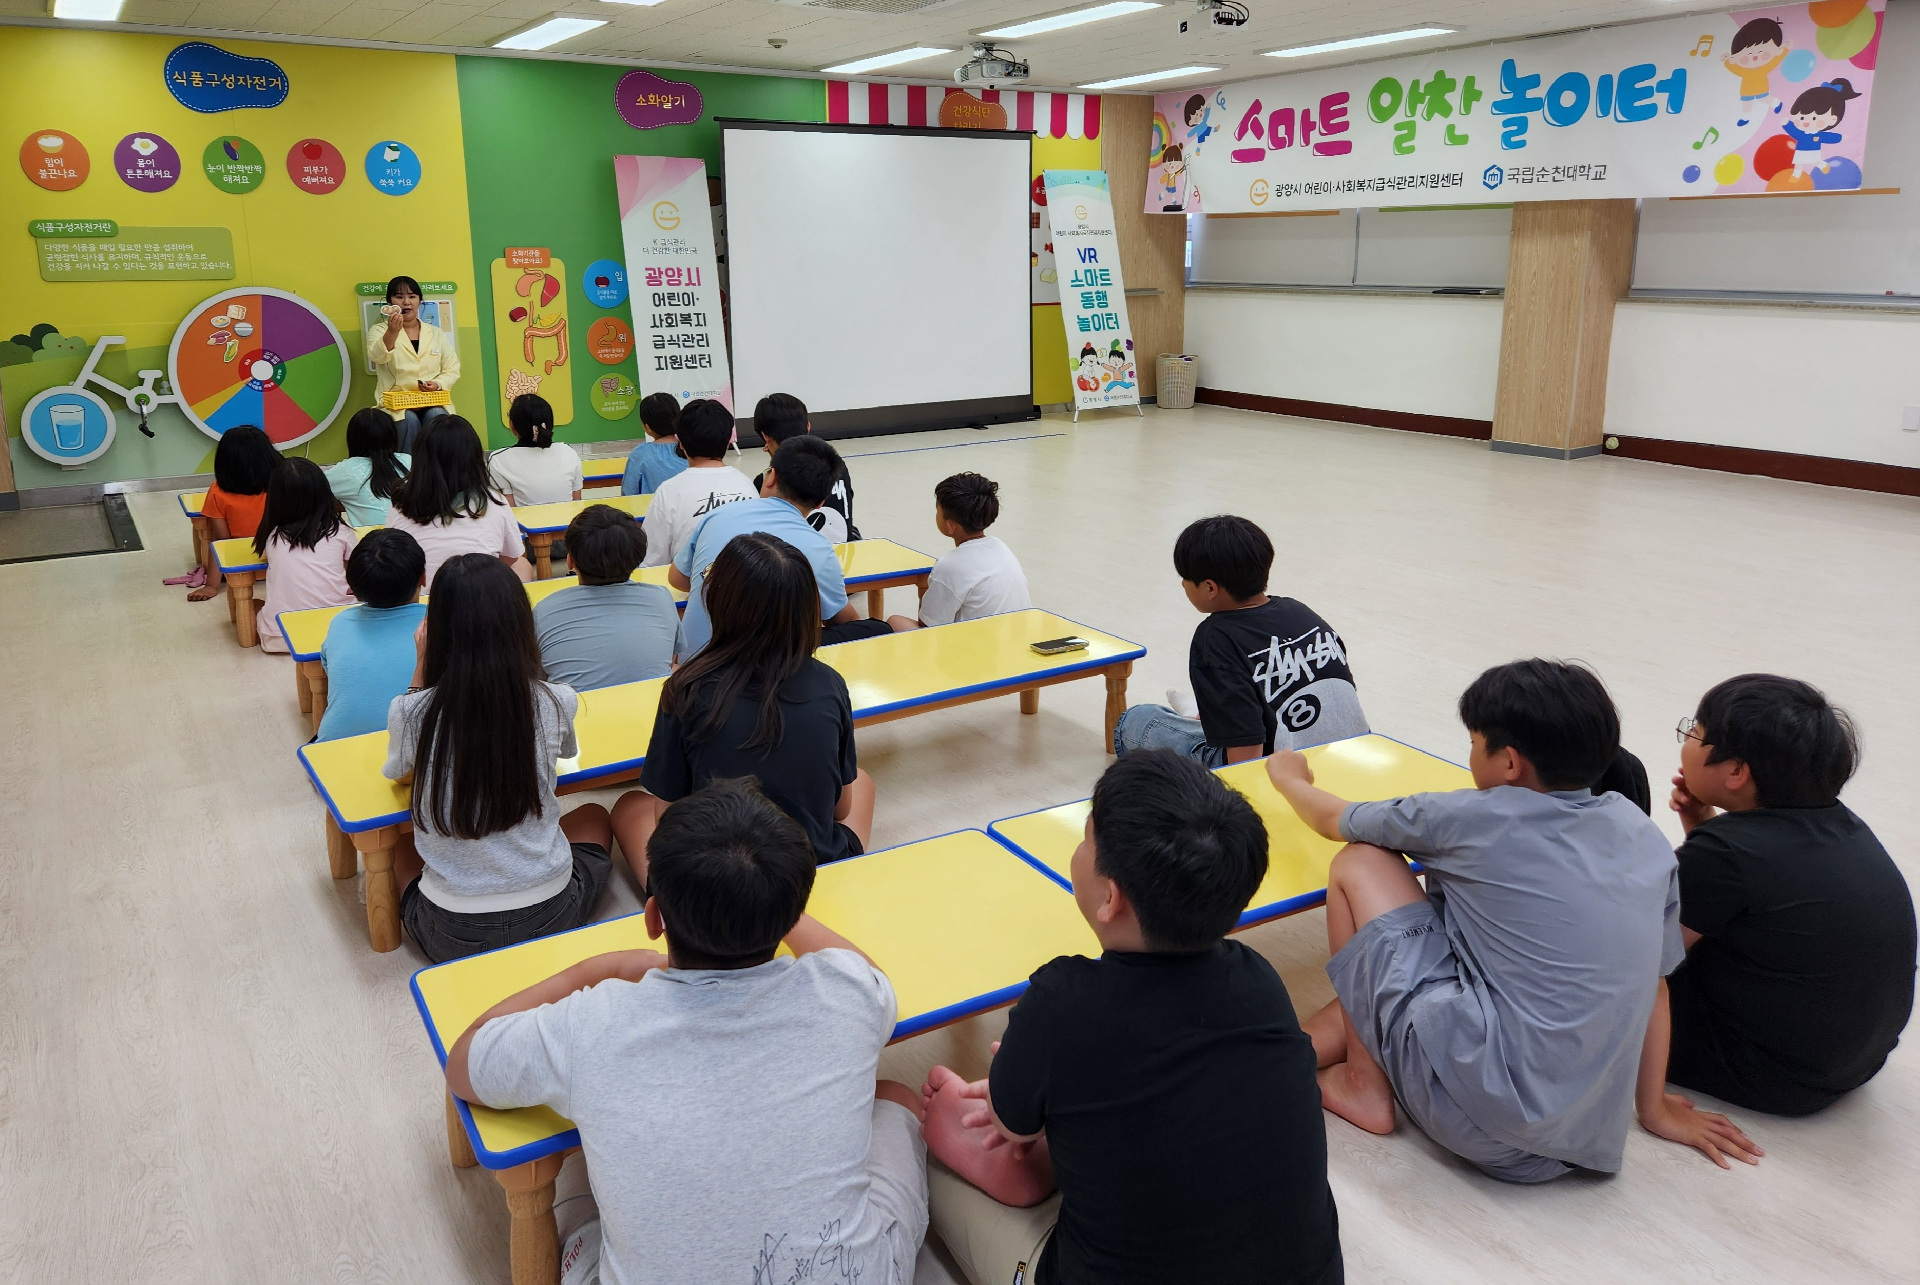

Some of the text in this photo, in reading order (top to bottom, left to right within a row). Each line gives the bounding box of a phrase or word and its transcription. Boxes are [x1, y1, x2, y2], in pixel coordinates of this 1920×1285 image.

[172, 71, 283, 90] 식품구성자전거
[635, 92, 685, 110] 소화알기
[953, 105, 990, 118] 건강식단
[1231, 58, 1687, 164] 스마트 알찬 놀이터
[45, 158, 64, 167] 힘이
[136, 158, 155, 168] 몸이
[125, 169, 173, 179] 튼튼해져요
[207, 164, 262, 175] 눈이 반짝반짝
[303, 166, 328, 175] 피부가
[386, 168, 401, 177] 키가
[1507, 164, 1607, 185] 국립순천대학교
[223, 175, 250, 184] 해져요
[302, 176, 335, 185] 예뻐져요
[379, 179, 394, 187] 쑥쑥
[1275, 172, 1463, 198] 광양시 어린이·사회복지급식관리지원센터
[36, 222, 111, 233] 식품구성자전거란
[44, 243, 69, 252] 다양한
[72, 243, 96, 252] 식품을
[99, 243, 116, 252] 매일
[118, 243, 142, 252] 필요한
[652, 247, 671, 255] 건강한
[672, 247, 698, 255] 대한민국
[81, 253, 104, 262] 식사를
[144, 253, 175, 262] 규칙적인
[1077, 247, 1098, 263] VR
[93, 262, 109, 271] 나갈
[112, 262, 121, 271] 수
[123, 262, 146, 271] 있다는
[149, 262, 164, 271] 것을
[168, 262, 198, 271] 표현하고
[200, 262, 232, 270] 있습니다.
[512, 257, 543, 265] 찾아보아요!
[614, 271, 624, 282] 입
[645, 267, 701, 287] 광양시
[1071, 268, 1113, 287] 스마트
[362, 284, 382, 292] 건강에
[652, 292, 700, 308] 어린이·
[1081, 289, 1109, 309] 동행
[650, 312, 707, 329] 사회복지
[1077, 312, 1120, 332] 놀이터
[618, 333, 627, 343] 위
[652, 333, 710, 349] 급식관리
[654, 354, 712, 371] 지원센터
[617, 385, 635, 396] 소장
[1287, 699, 1316, 728] 8
